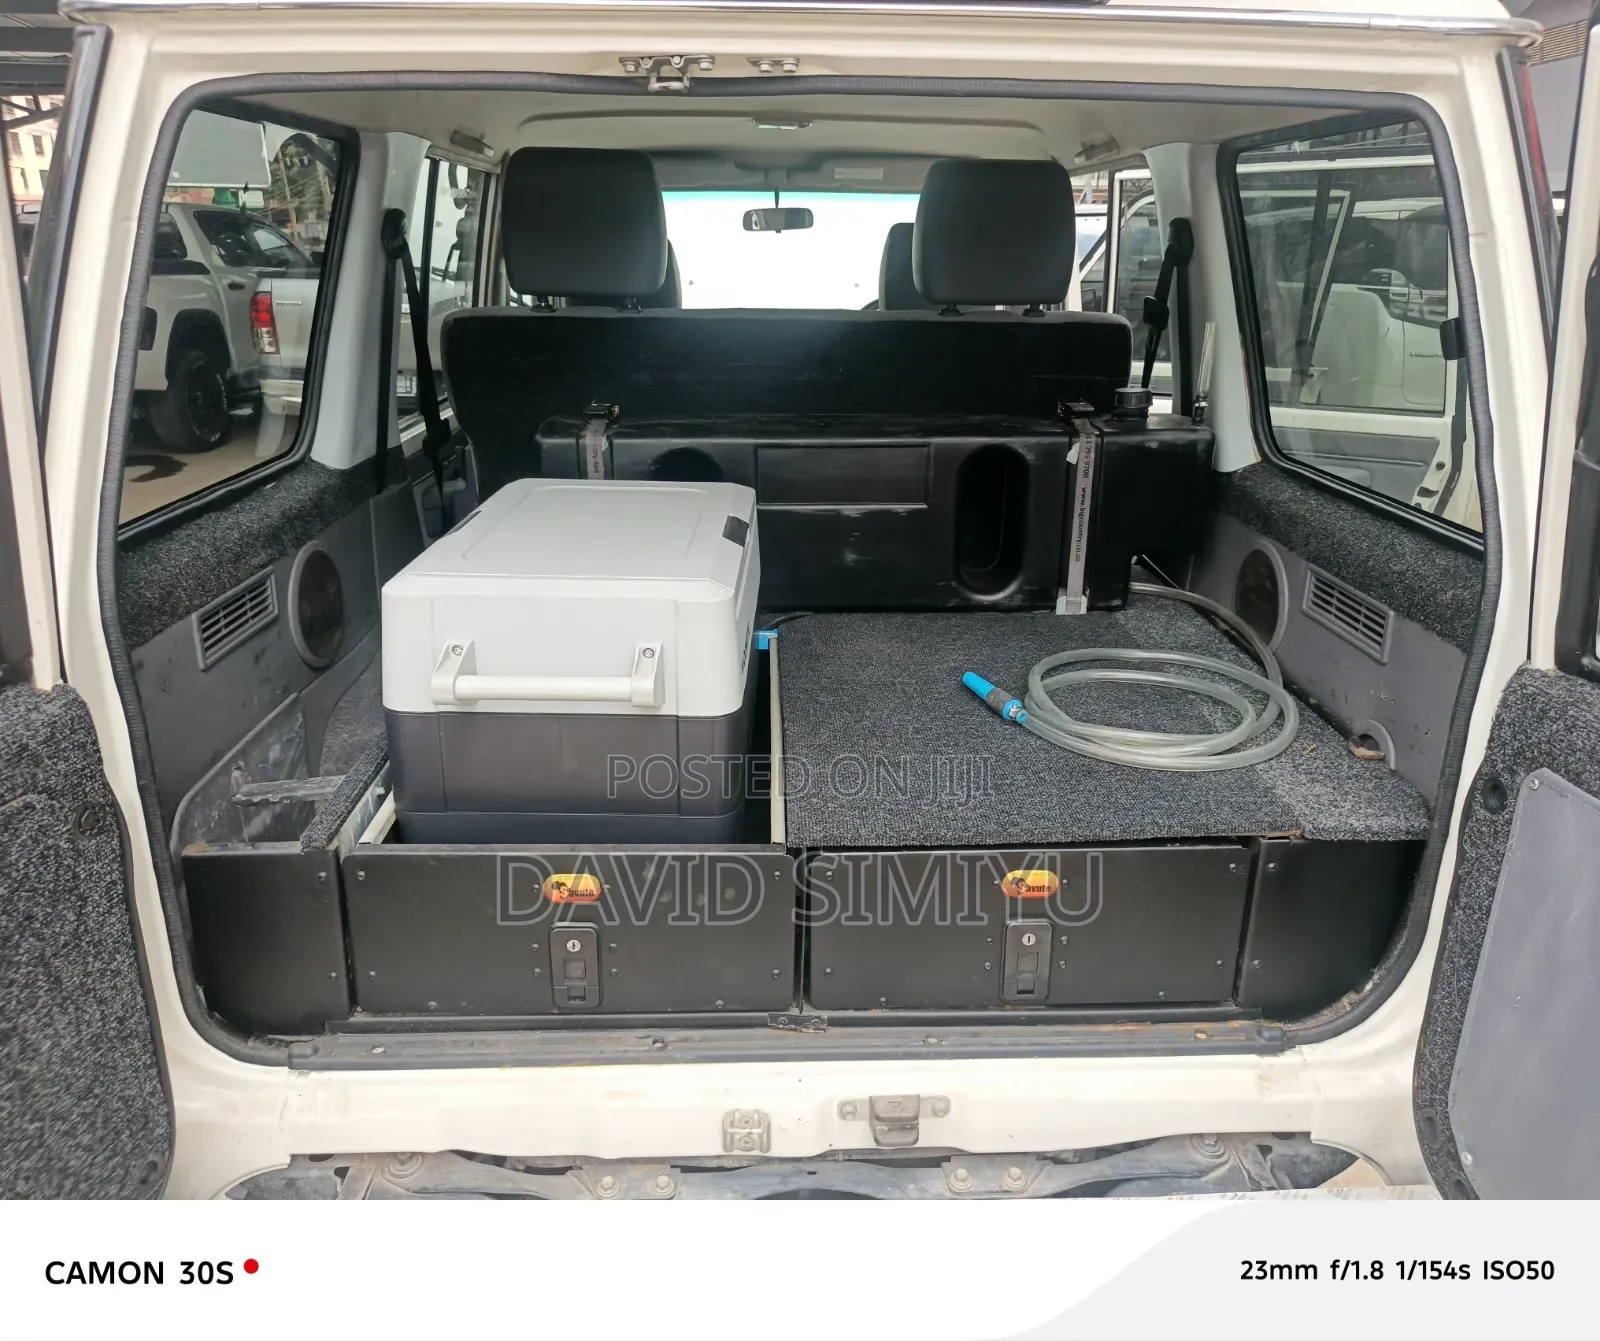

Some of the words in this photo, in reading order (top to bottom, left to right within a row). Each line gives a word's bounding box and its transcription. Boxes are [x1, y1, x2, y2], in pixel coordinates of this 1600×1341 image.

[1084, 447, 1092, 459] 795
[1082, 461, 1091, 478] 9700
[1075, 486, 1087, 562] www.bigcountry.co.za
[559, 884, 595, 899] Savute
[1016, 880, 1051, 896] Savute
